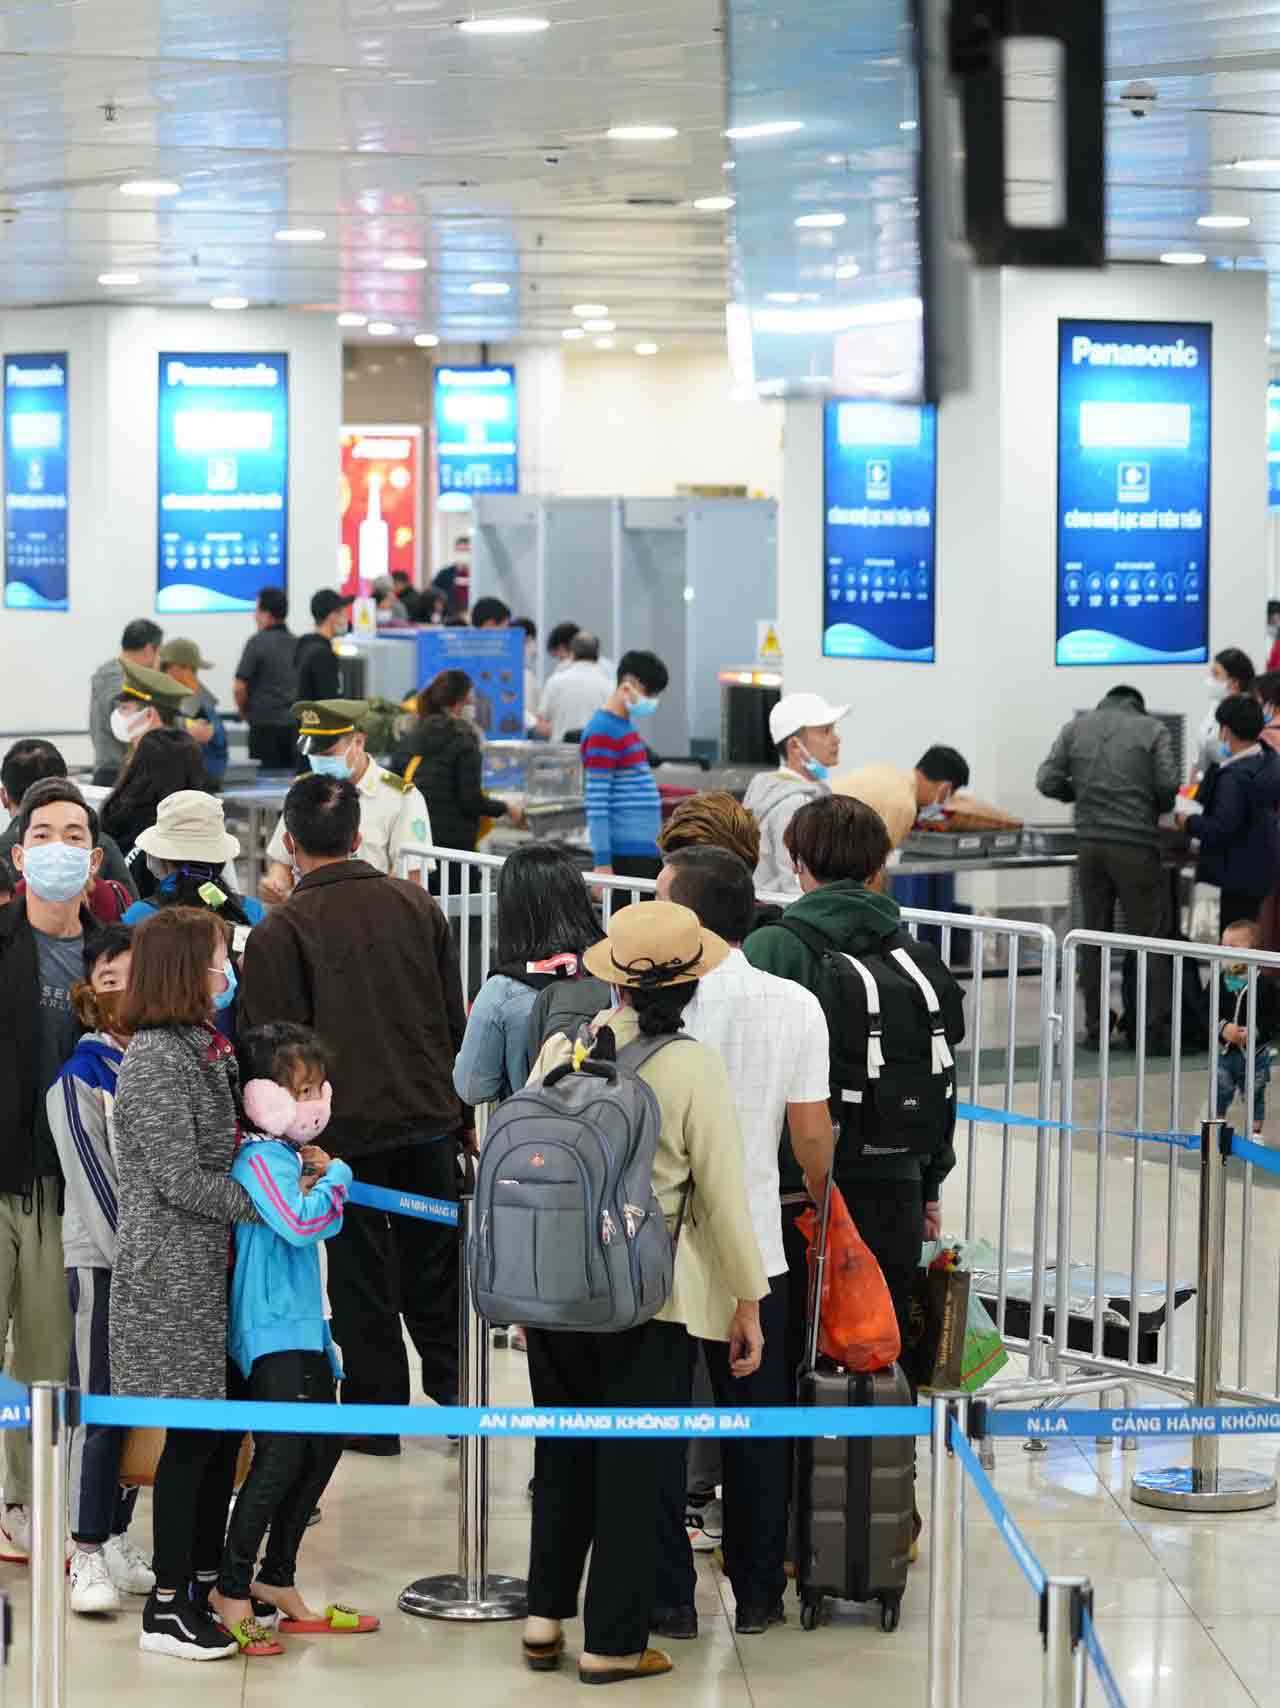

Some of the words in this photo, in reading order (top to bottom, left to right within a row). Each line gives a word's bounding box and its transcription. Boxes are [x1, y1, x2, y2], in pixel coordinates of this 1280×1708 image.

[1072, 335, 1199, 368] Panasonic
[479, 1413, 507, 1429] AN
[511, 1413, 555, 1430] NINH
[559, 1411, 612, 1430] HÀNG
[615, 1411, 680, 1431] KHÔNG
[1026, 1417, 1068, 1433] N.I.A
[1166, 1410, 1216, 1432] HÀNG
